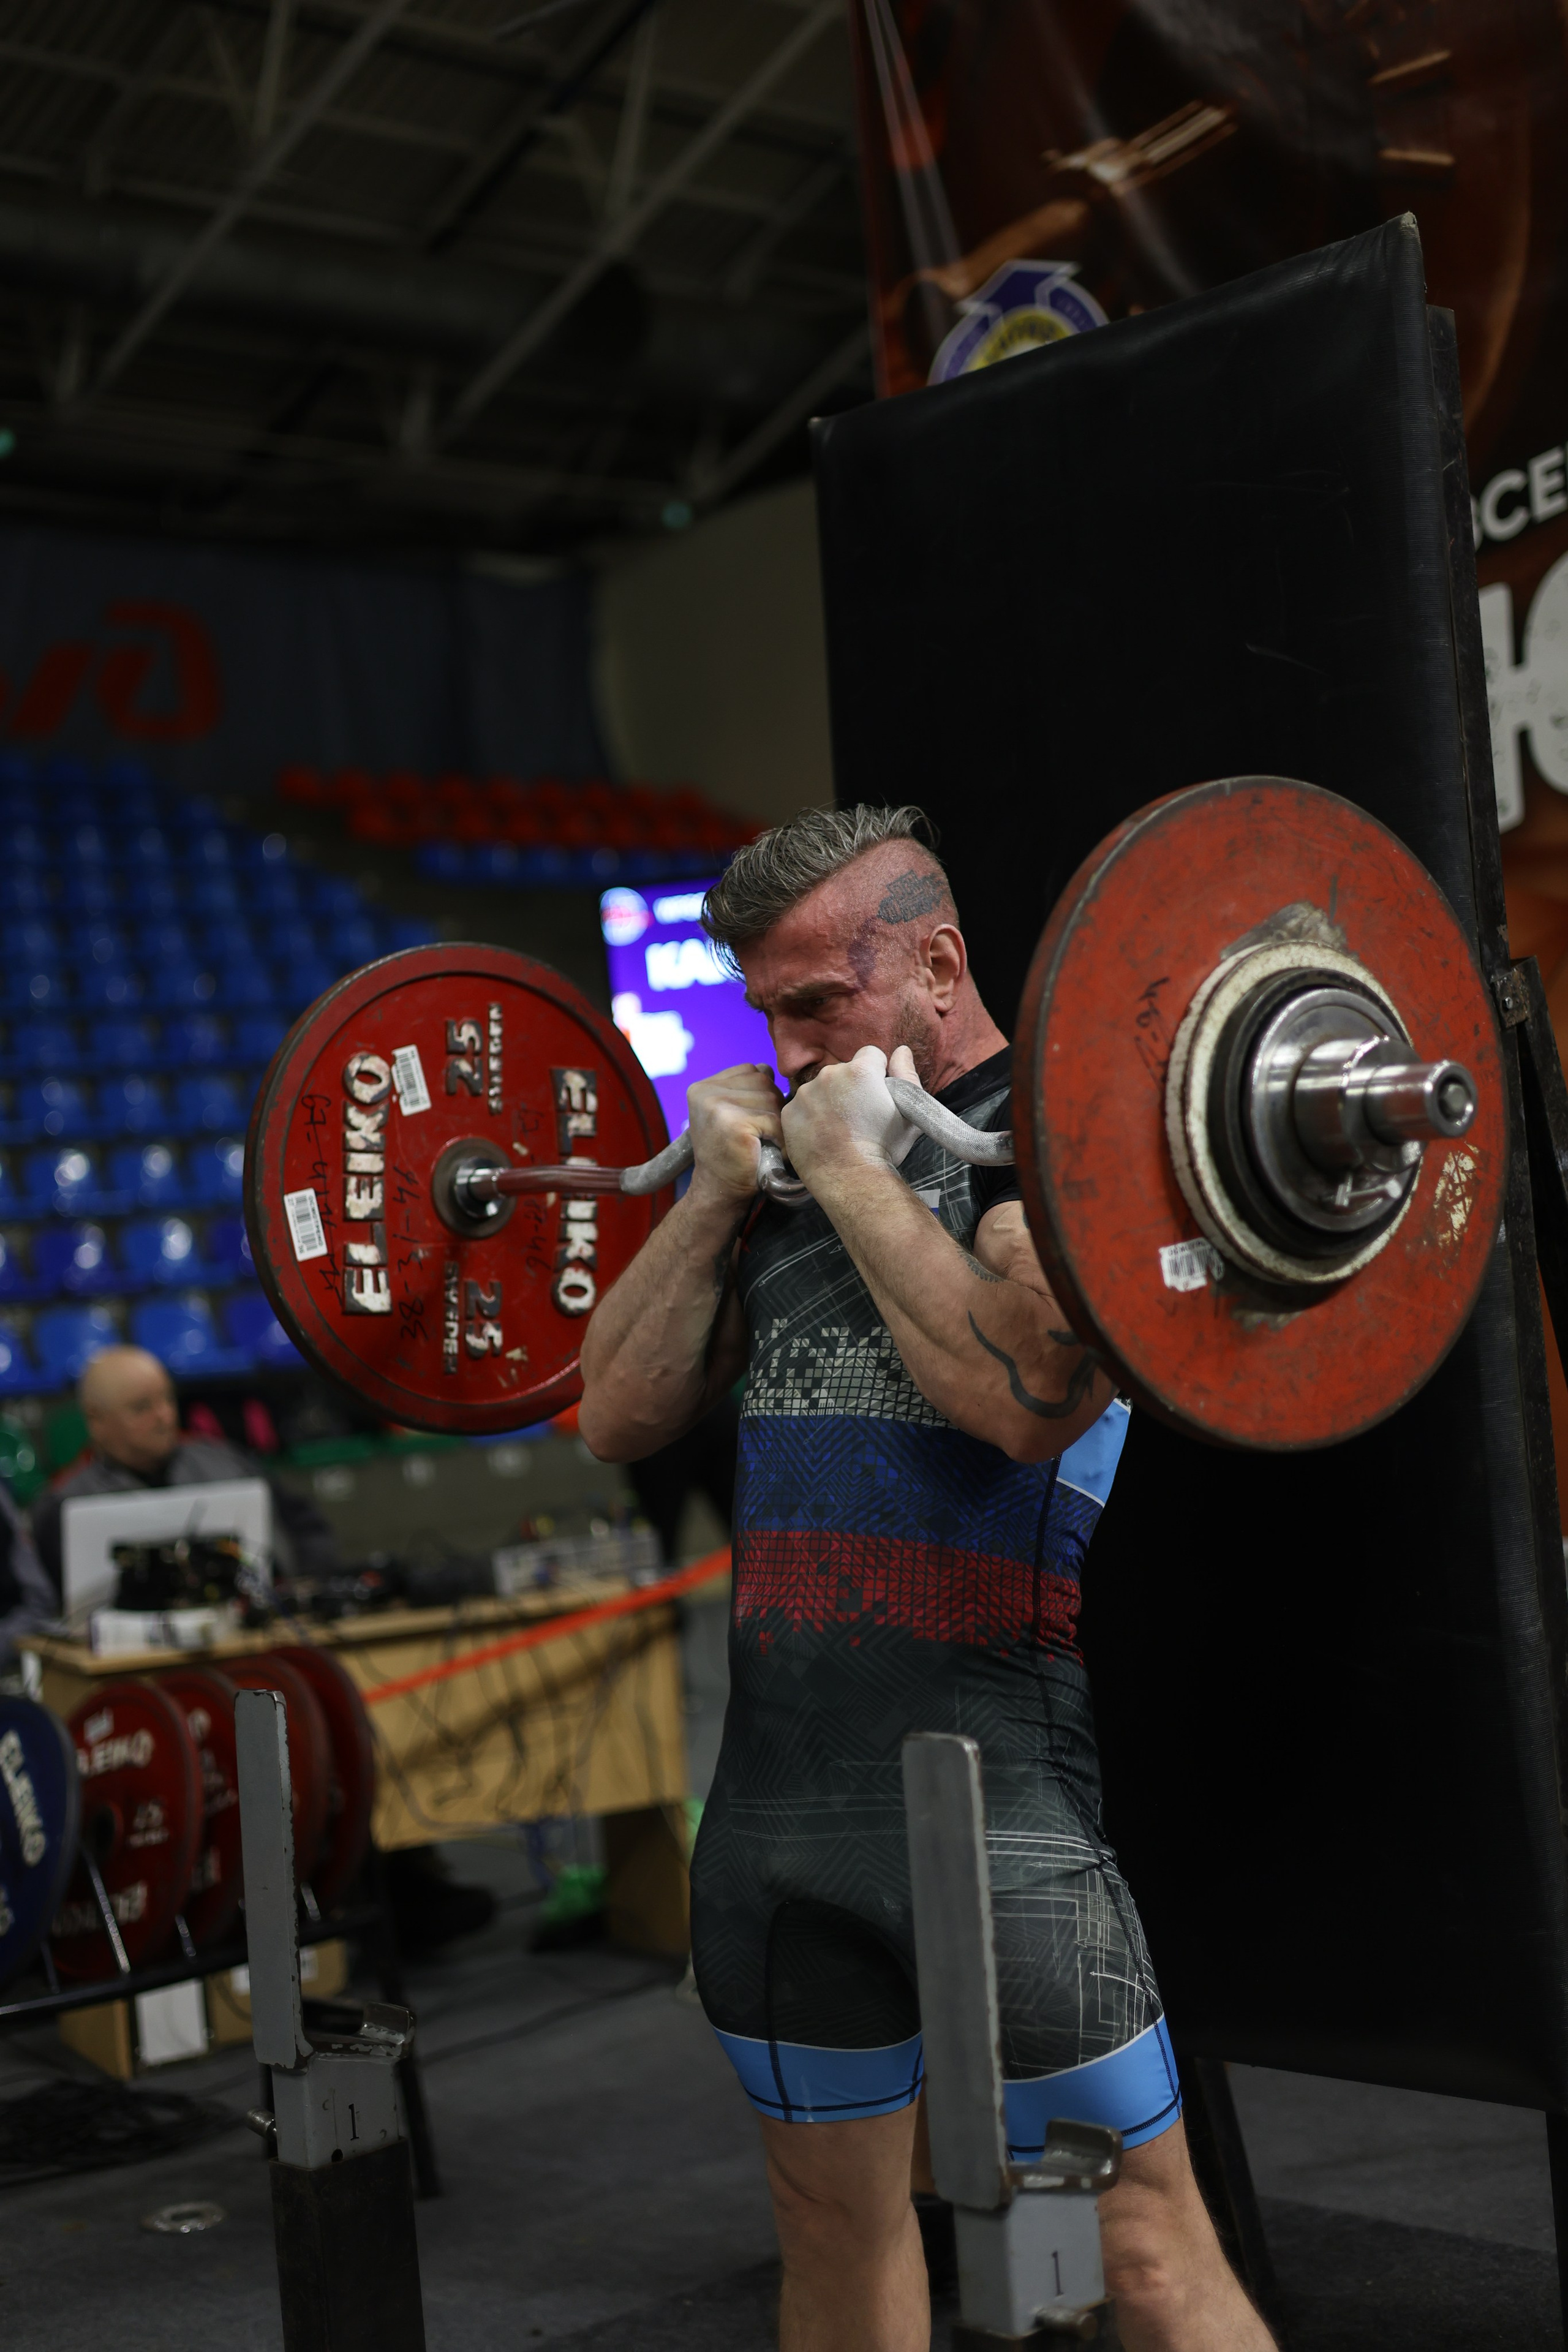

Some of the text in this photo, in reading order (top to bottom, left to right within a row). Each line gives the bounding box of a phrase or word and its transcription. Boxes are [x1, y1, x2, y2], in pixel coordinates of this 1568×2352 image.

[445, 1018, 483, 1096] 25
[344, 1050, 393, 1315] ELEIKO
[465, 1279, 503, 1360] 25
[348, 2103, 360, 2141] 1
[1052, 2252, 1063, 2296] 1
